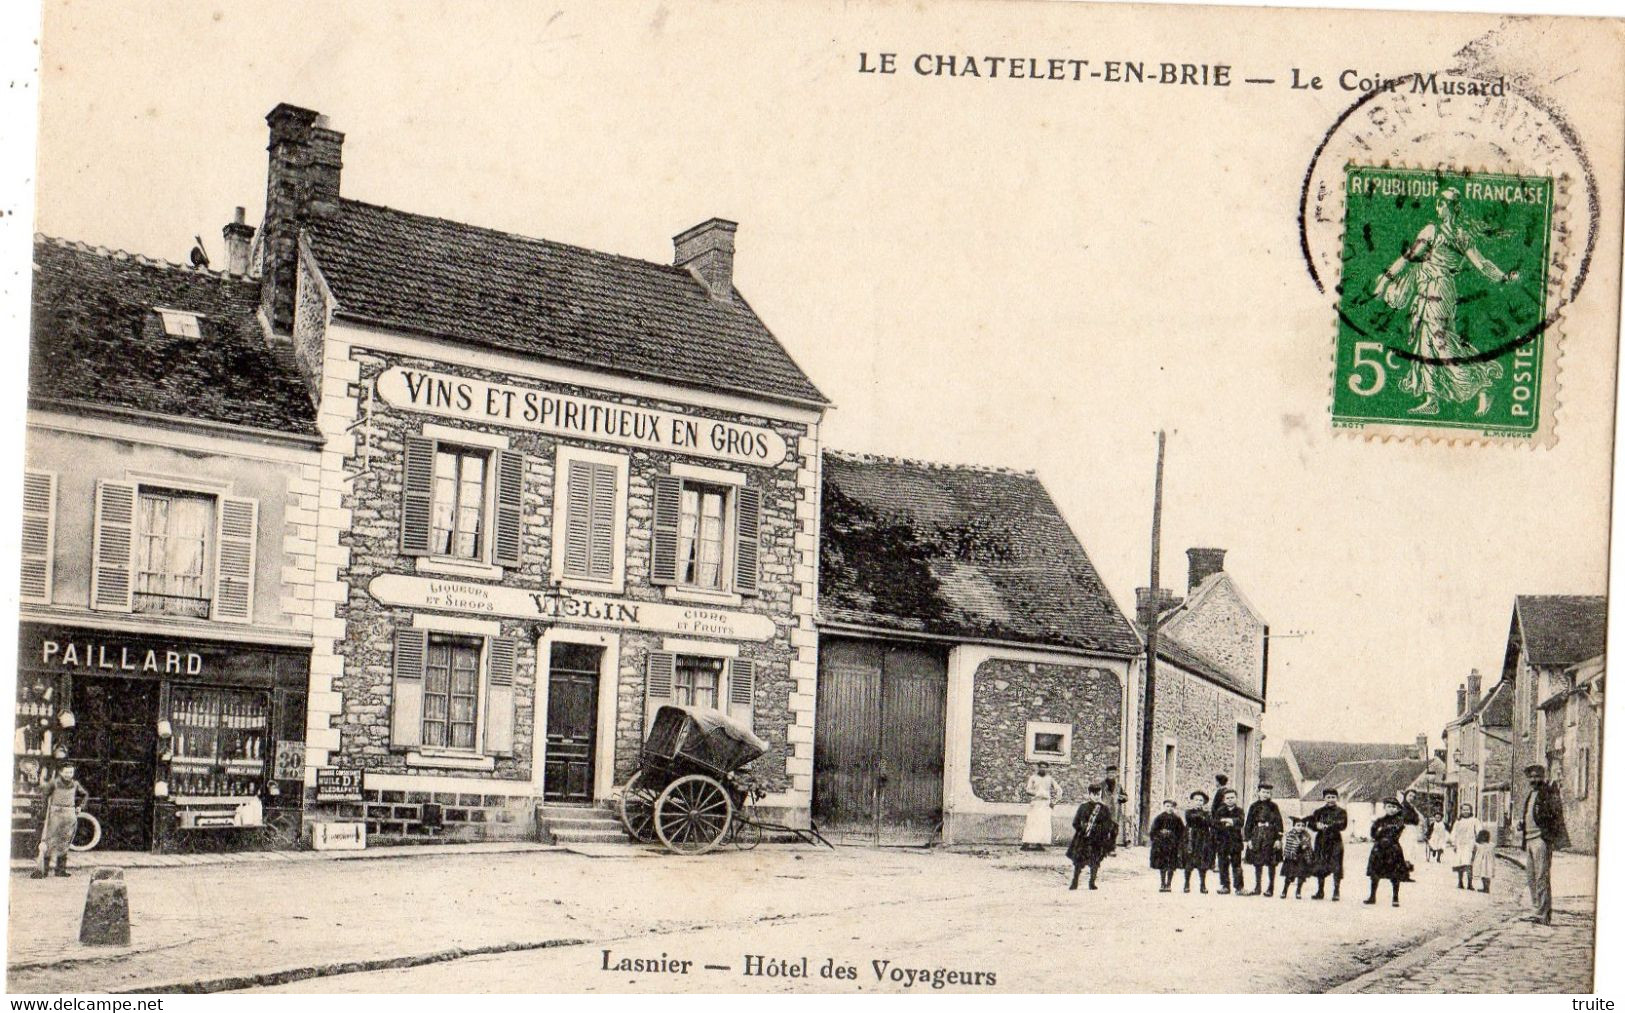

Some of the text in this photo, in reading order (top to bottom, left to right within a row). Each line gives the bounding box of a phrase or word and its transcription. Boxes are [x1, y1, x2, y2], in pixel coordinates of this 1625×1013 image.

[1511, 335, 1536, 416] POSTE
[400, 370, 769, 459] VINS ET SPIRITUEUX EN GROS
[683, 609, 728, 624] CIDRE
[42, 640, 203, 676] PAILLARD
